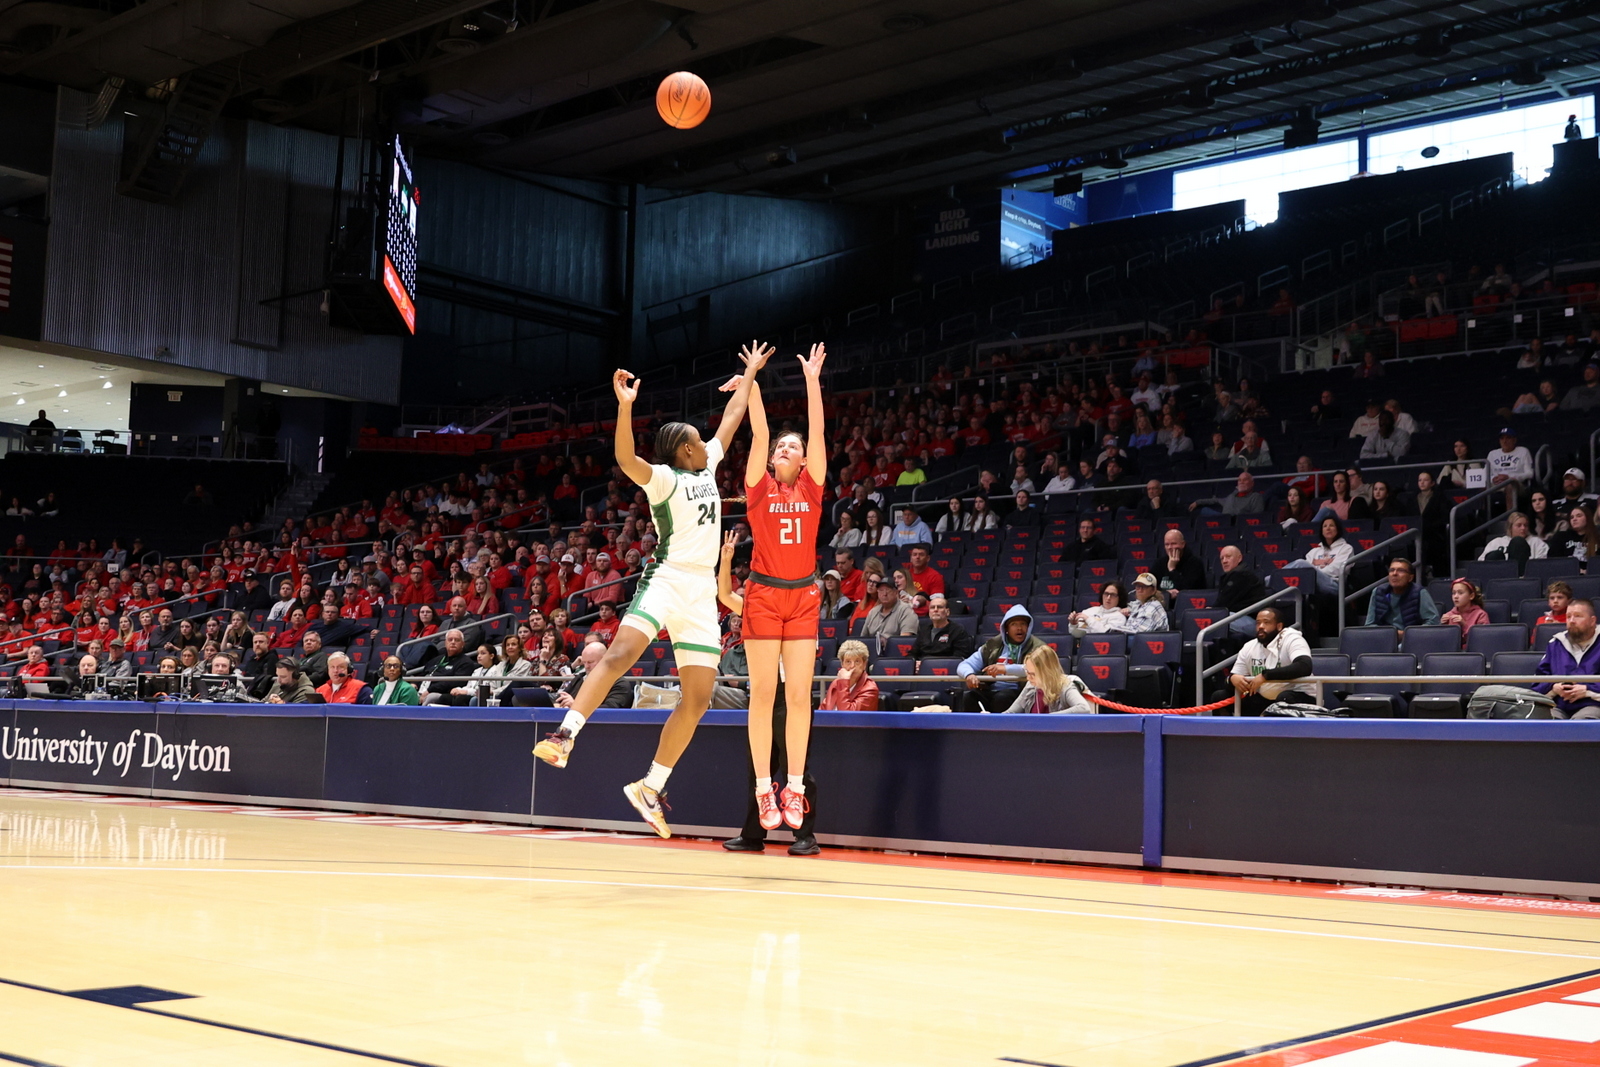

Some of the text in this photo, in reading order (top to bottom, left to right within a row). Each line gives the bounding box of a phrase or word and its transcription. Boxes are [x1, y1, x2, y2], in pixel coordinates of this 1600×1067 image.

[940, 208, 966, 222] BUD
[934, 218, 970, 234] LIGHT
[925, 230, 980, 250] LANDING
[1494, 454, 1520, 465] DUKE
[698, 502, 716, 526] 24
[768, 502, 810, 513] BELLEVUE
[779, 517, 802, 545] 21
[2, 726, 232, 781] University of Dayton
